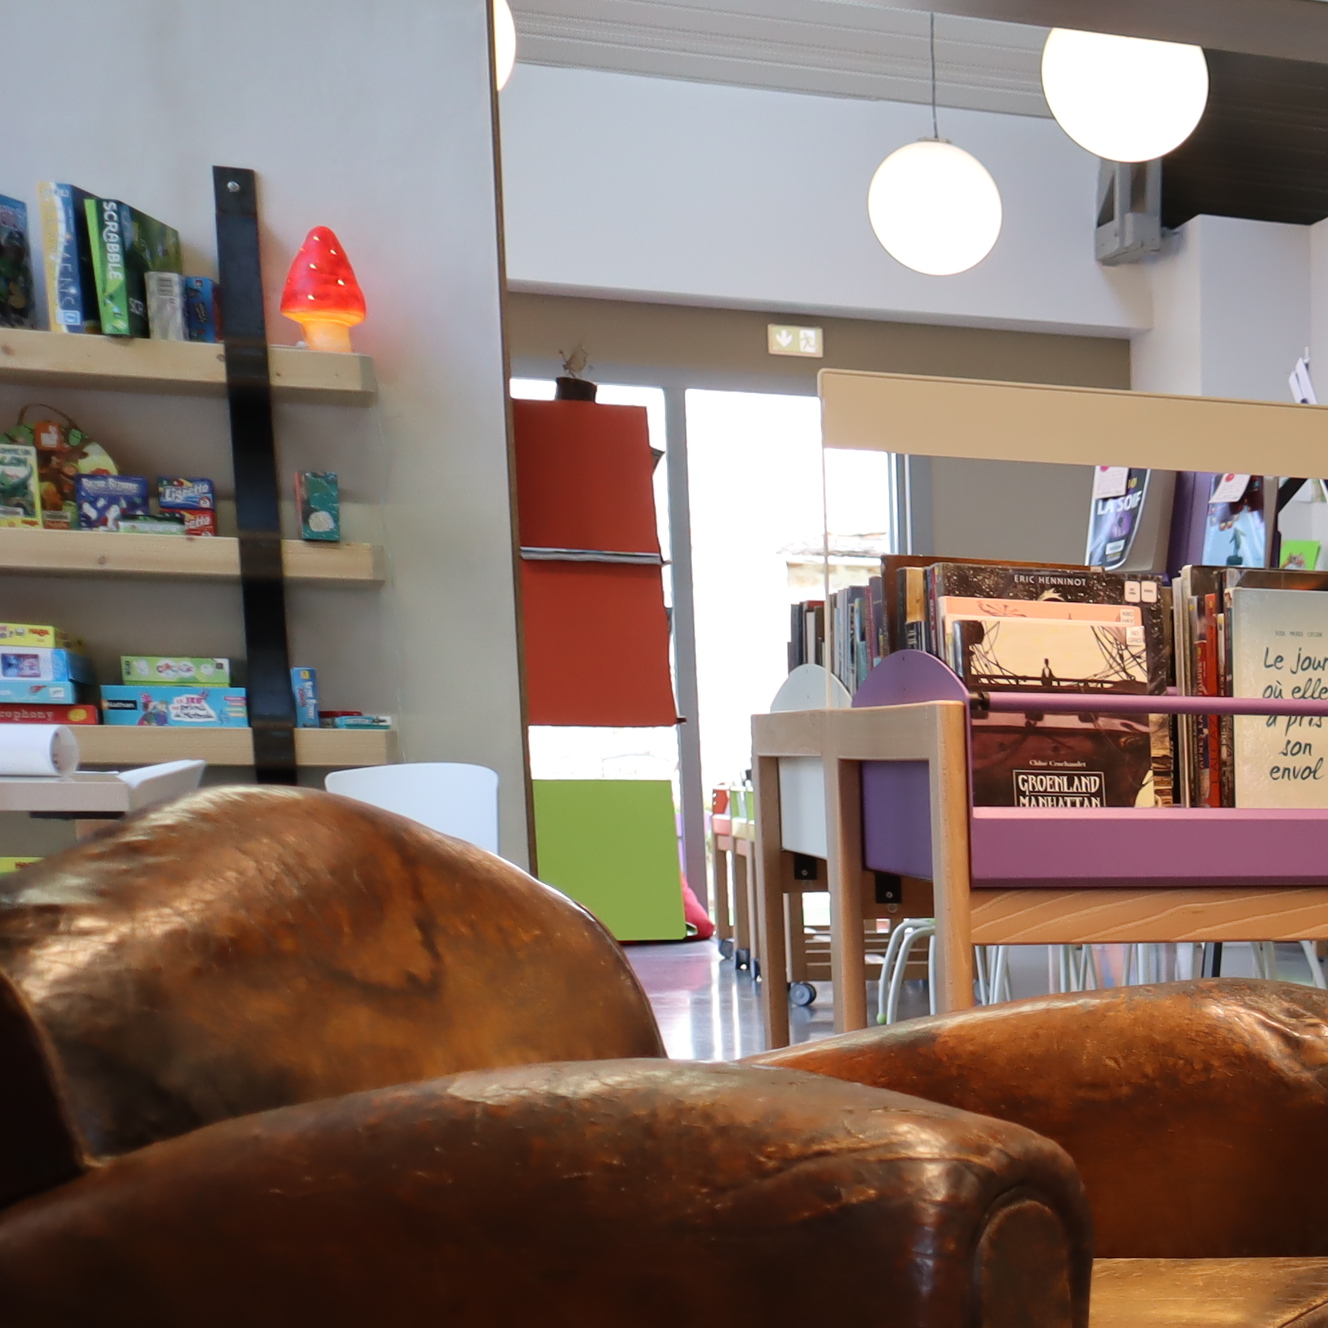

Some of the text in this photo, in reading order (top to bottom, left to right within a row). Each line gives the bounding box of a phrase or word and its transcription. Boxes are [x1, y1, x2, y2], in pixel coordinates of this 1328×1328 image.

[102, 201, 124, 281] SCRABBLE
[1097, 489, 1141, 515] LA SOIF
[1014, 574, 1087, 588] ERIC HENNINOT
[1263, 647, 1284, 670] Le
[1262, 677, 1328, 700] où elle
[1279, 739, 1312, 757] son
[1269, 757, 1325, 781] envol
[1018, 774, 1100, 795] GROENLAND
[1019, 796, 1100, 808] MANHATTAN
